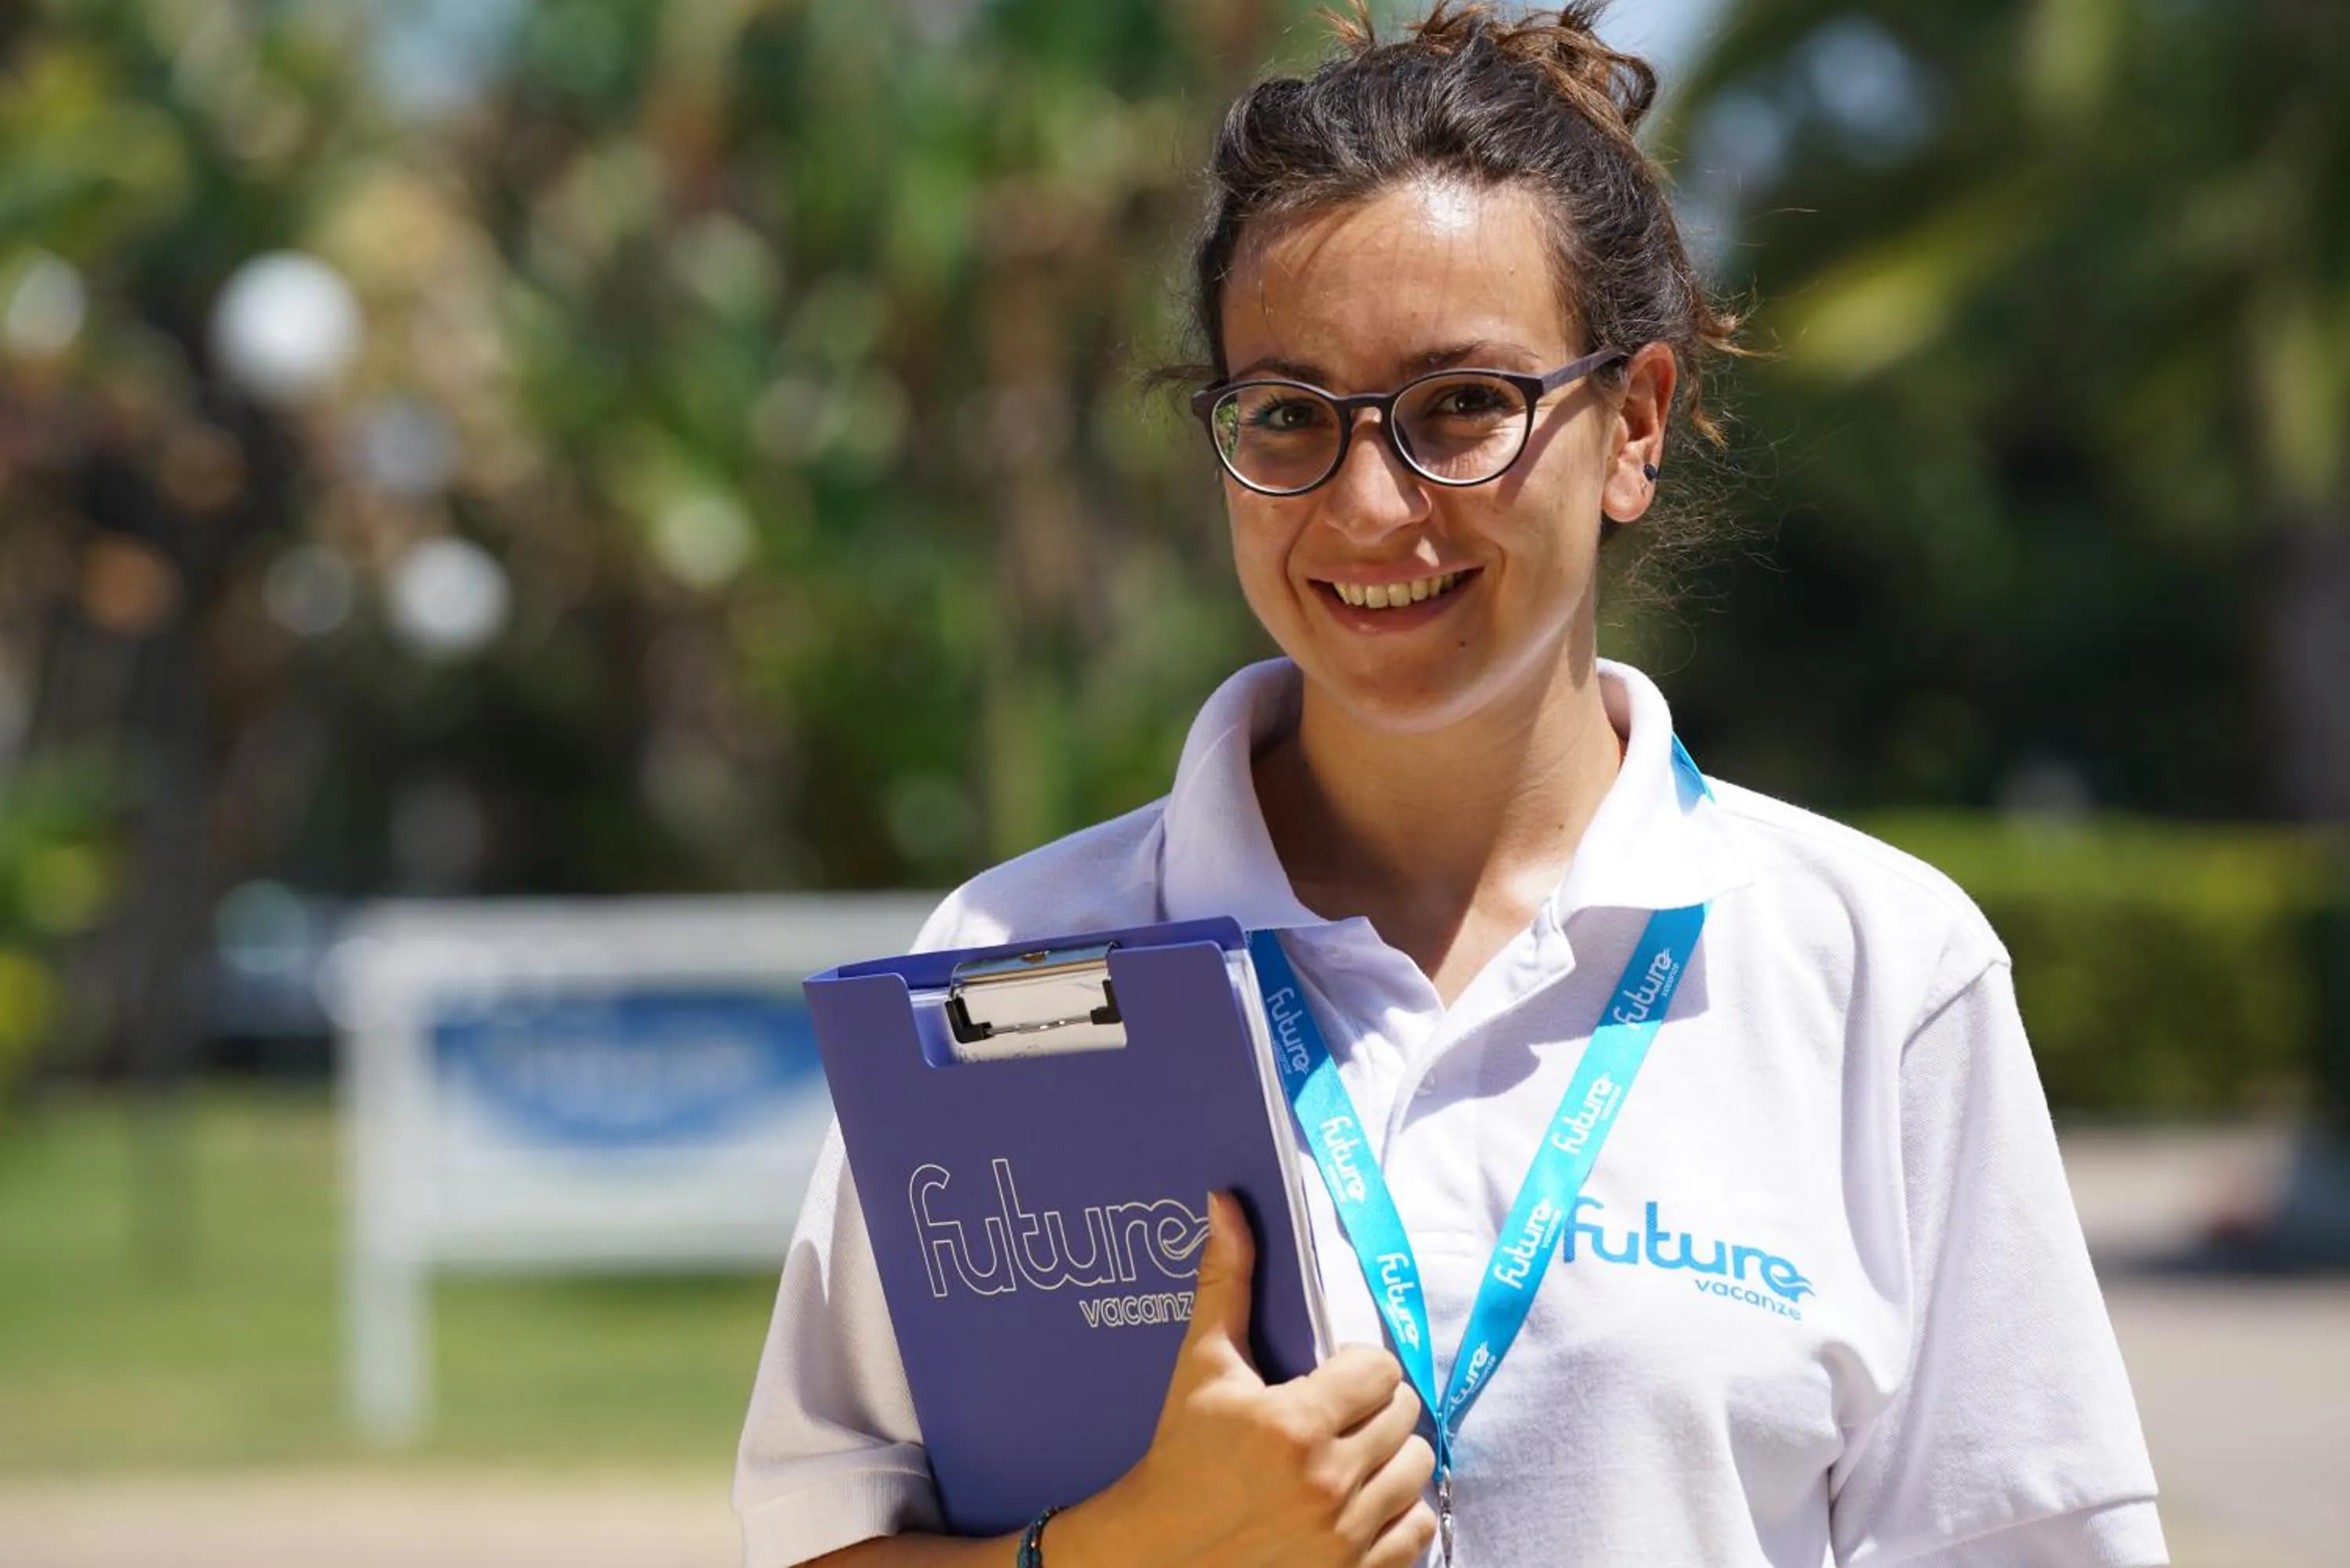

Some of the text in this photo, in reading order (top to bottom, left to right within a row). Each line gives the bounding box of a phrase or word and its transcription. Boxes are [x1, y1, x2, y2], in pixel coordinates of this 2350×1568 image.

[1267, 987, 1310, 1076] future
[1614, 947, 1672, 1030] future
[1551, 1072, 1614, 1155] future
[1319, 1115, 1365, 1202] future
[909, 1158, 1211, 1298] future
[1493, 1198, 1551, 1290] future
[1563, 1197, 1816, 1303] future
[1079, 1292, 1195, 1328] vacanz
[1376, 1253, 1419, 1352] future
[1695, 1279, 1802, 1321] vacanze
